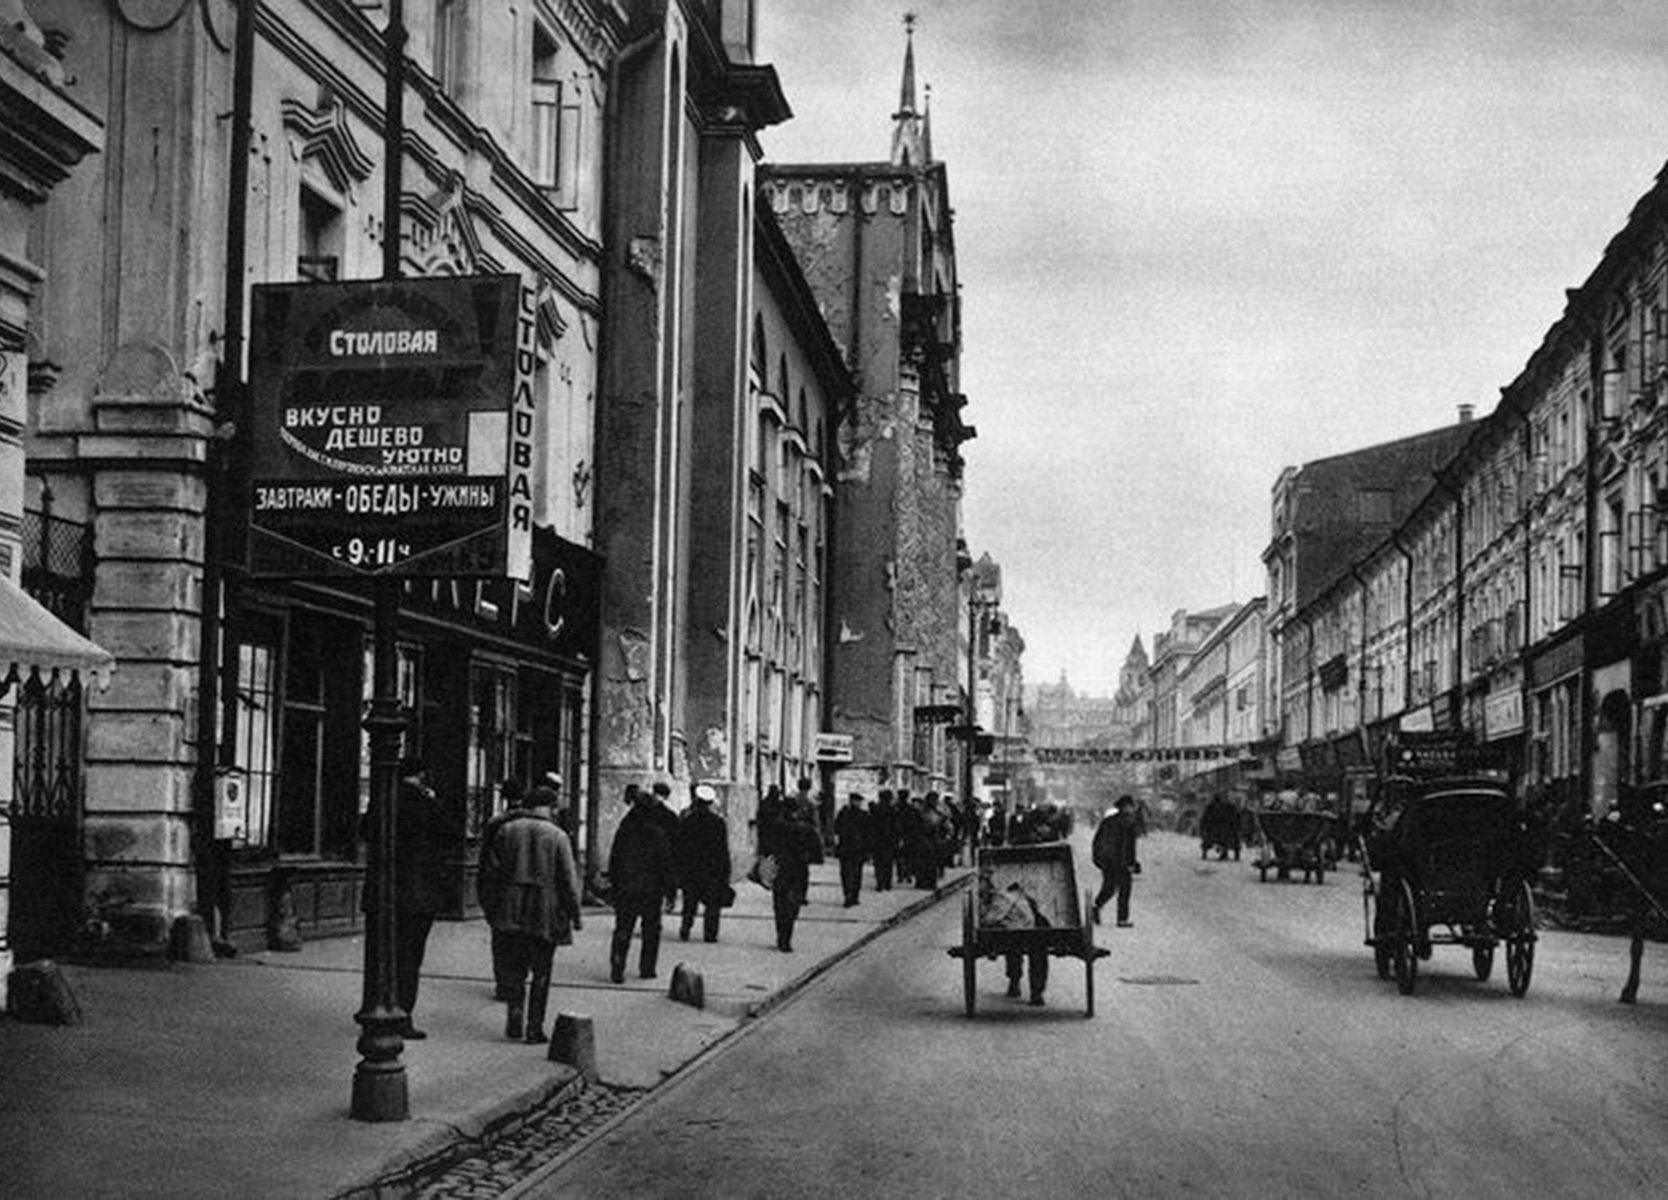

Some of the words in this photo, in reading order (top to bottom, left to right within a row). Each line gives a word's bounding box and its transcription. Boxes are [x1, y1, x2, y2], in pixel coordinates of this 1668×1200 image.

[330, 330, 437, 355] СТОЛОВАЯ
[286, 406, 381, 428] ВКУСНО
[511, 287, 535, 531] СТОЛОВАЯ
[325, 427, 423, 450] ДЕШЕВО
[382, 447, 462, 464] УЮТНО
[346, 483, 419, 515] ОБЕДЫ
